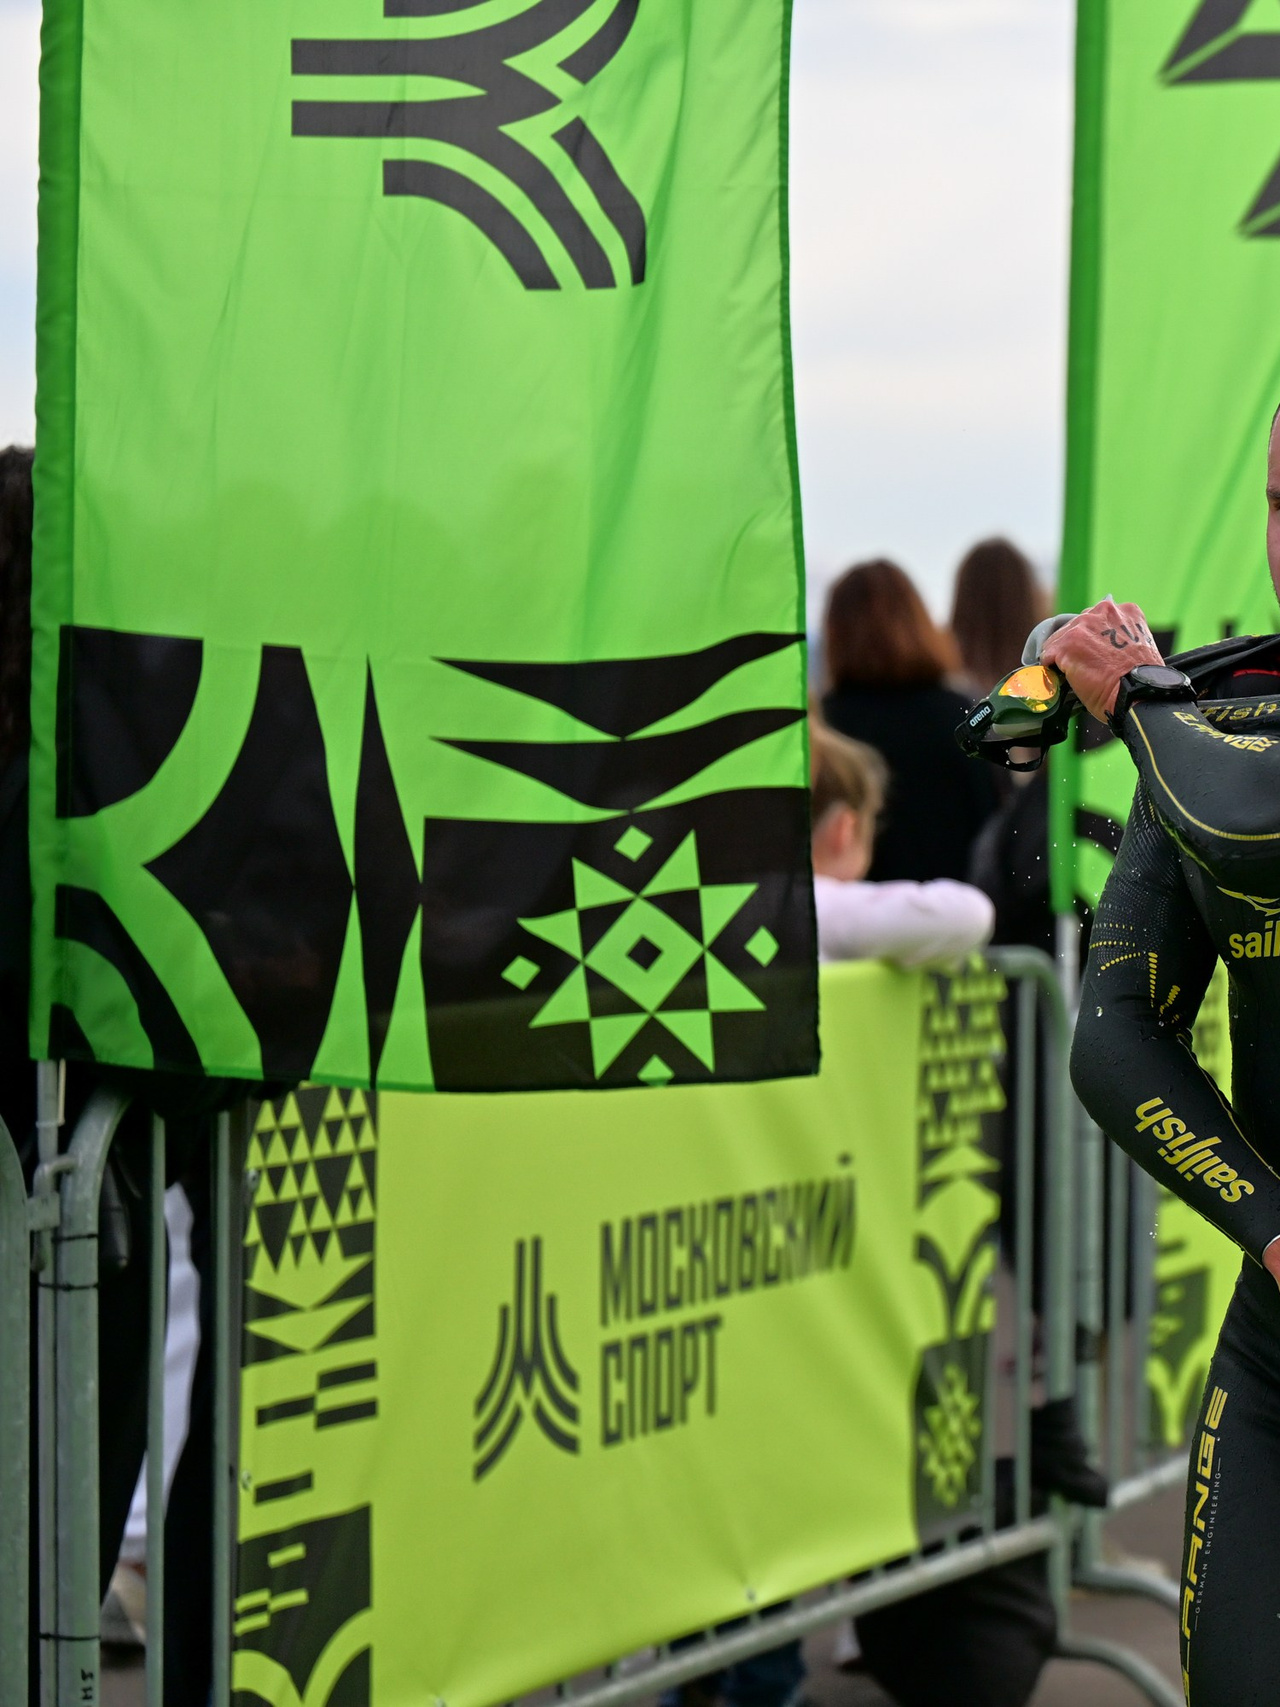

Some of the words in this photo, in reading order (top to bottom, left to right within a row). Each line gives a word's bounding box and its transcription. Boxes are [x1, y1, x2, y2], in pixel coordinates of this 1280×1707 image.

[970, 705, 991, 727] arena
[1134, 1097, 1255, 1203] sailfish
[600, 1151, 857, 1328] МОСКОВСКИЙ
[601, 1312, 722, 1448] СПОРТ
[1195, 1562, 1208, 1615] GERMAN
[1205, 1471, 1222, 1556] ENGINEERING
